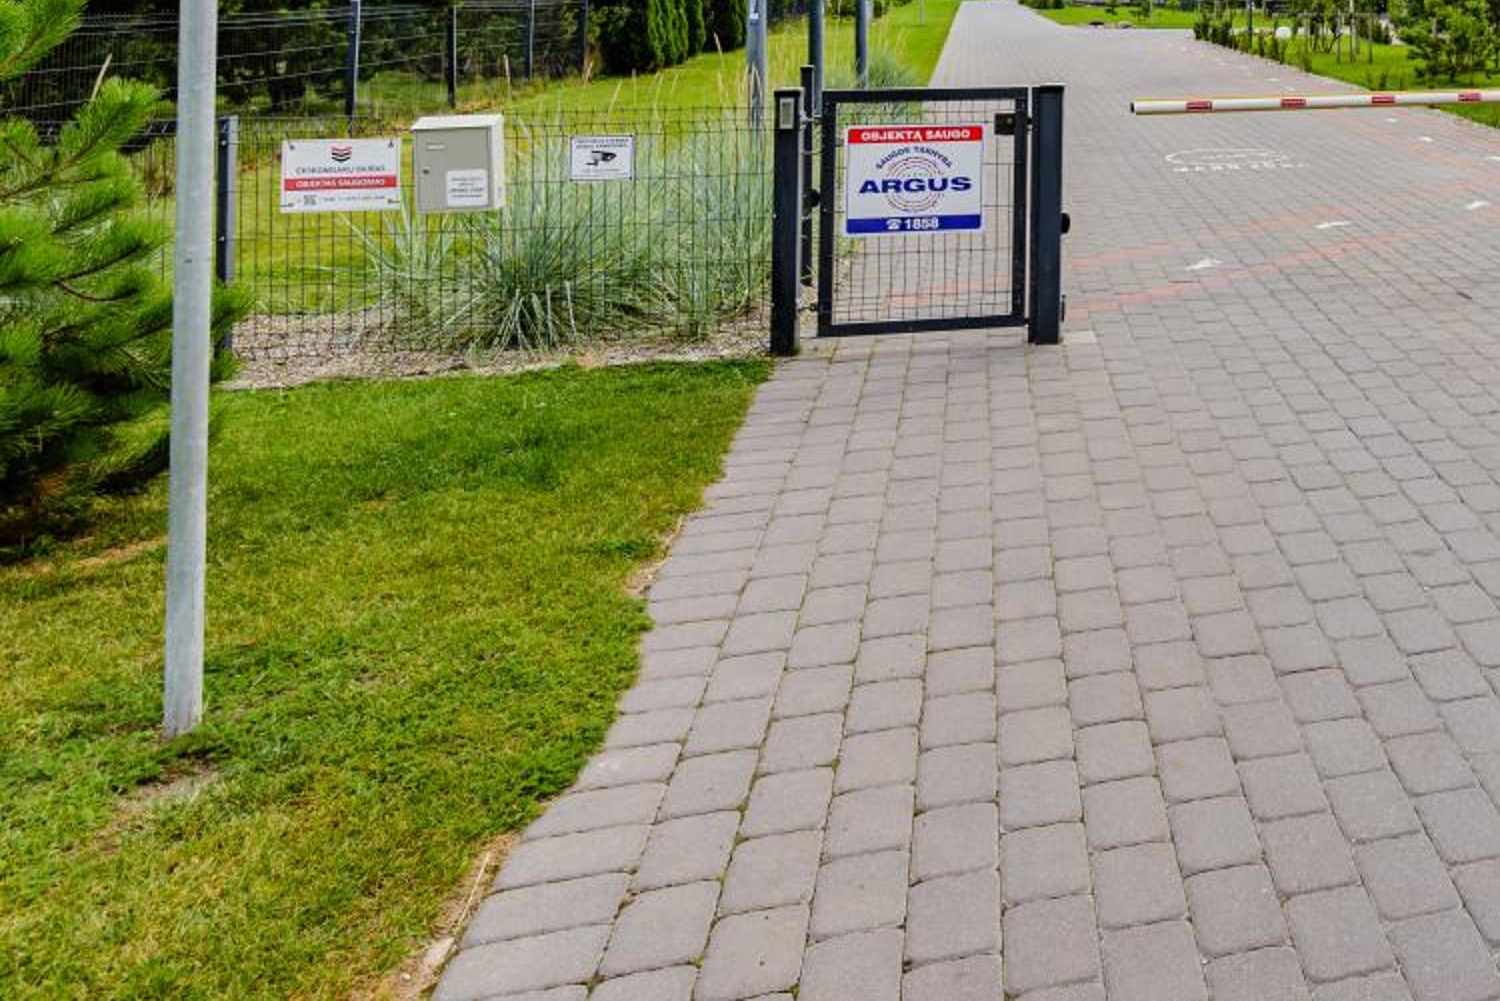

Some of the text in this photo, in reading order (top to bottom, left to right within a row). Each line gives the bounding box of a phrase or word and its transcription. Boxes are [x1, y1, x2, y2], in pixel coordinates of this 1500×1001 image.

[925, 129, 971, 140] SAUGO
[859, 176, 972, 194] ARGUS
[904, 217, 940, 230] 1858
